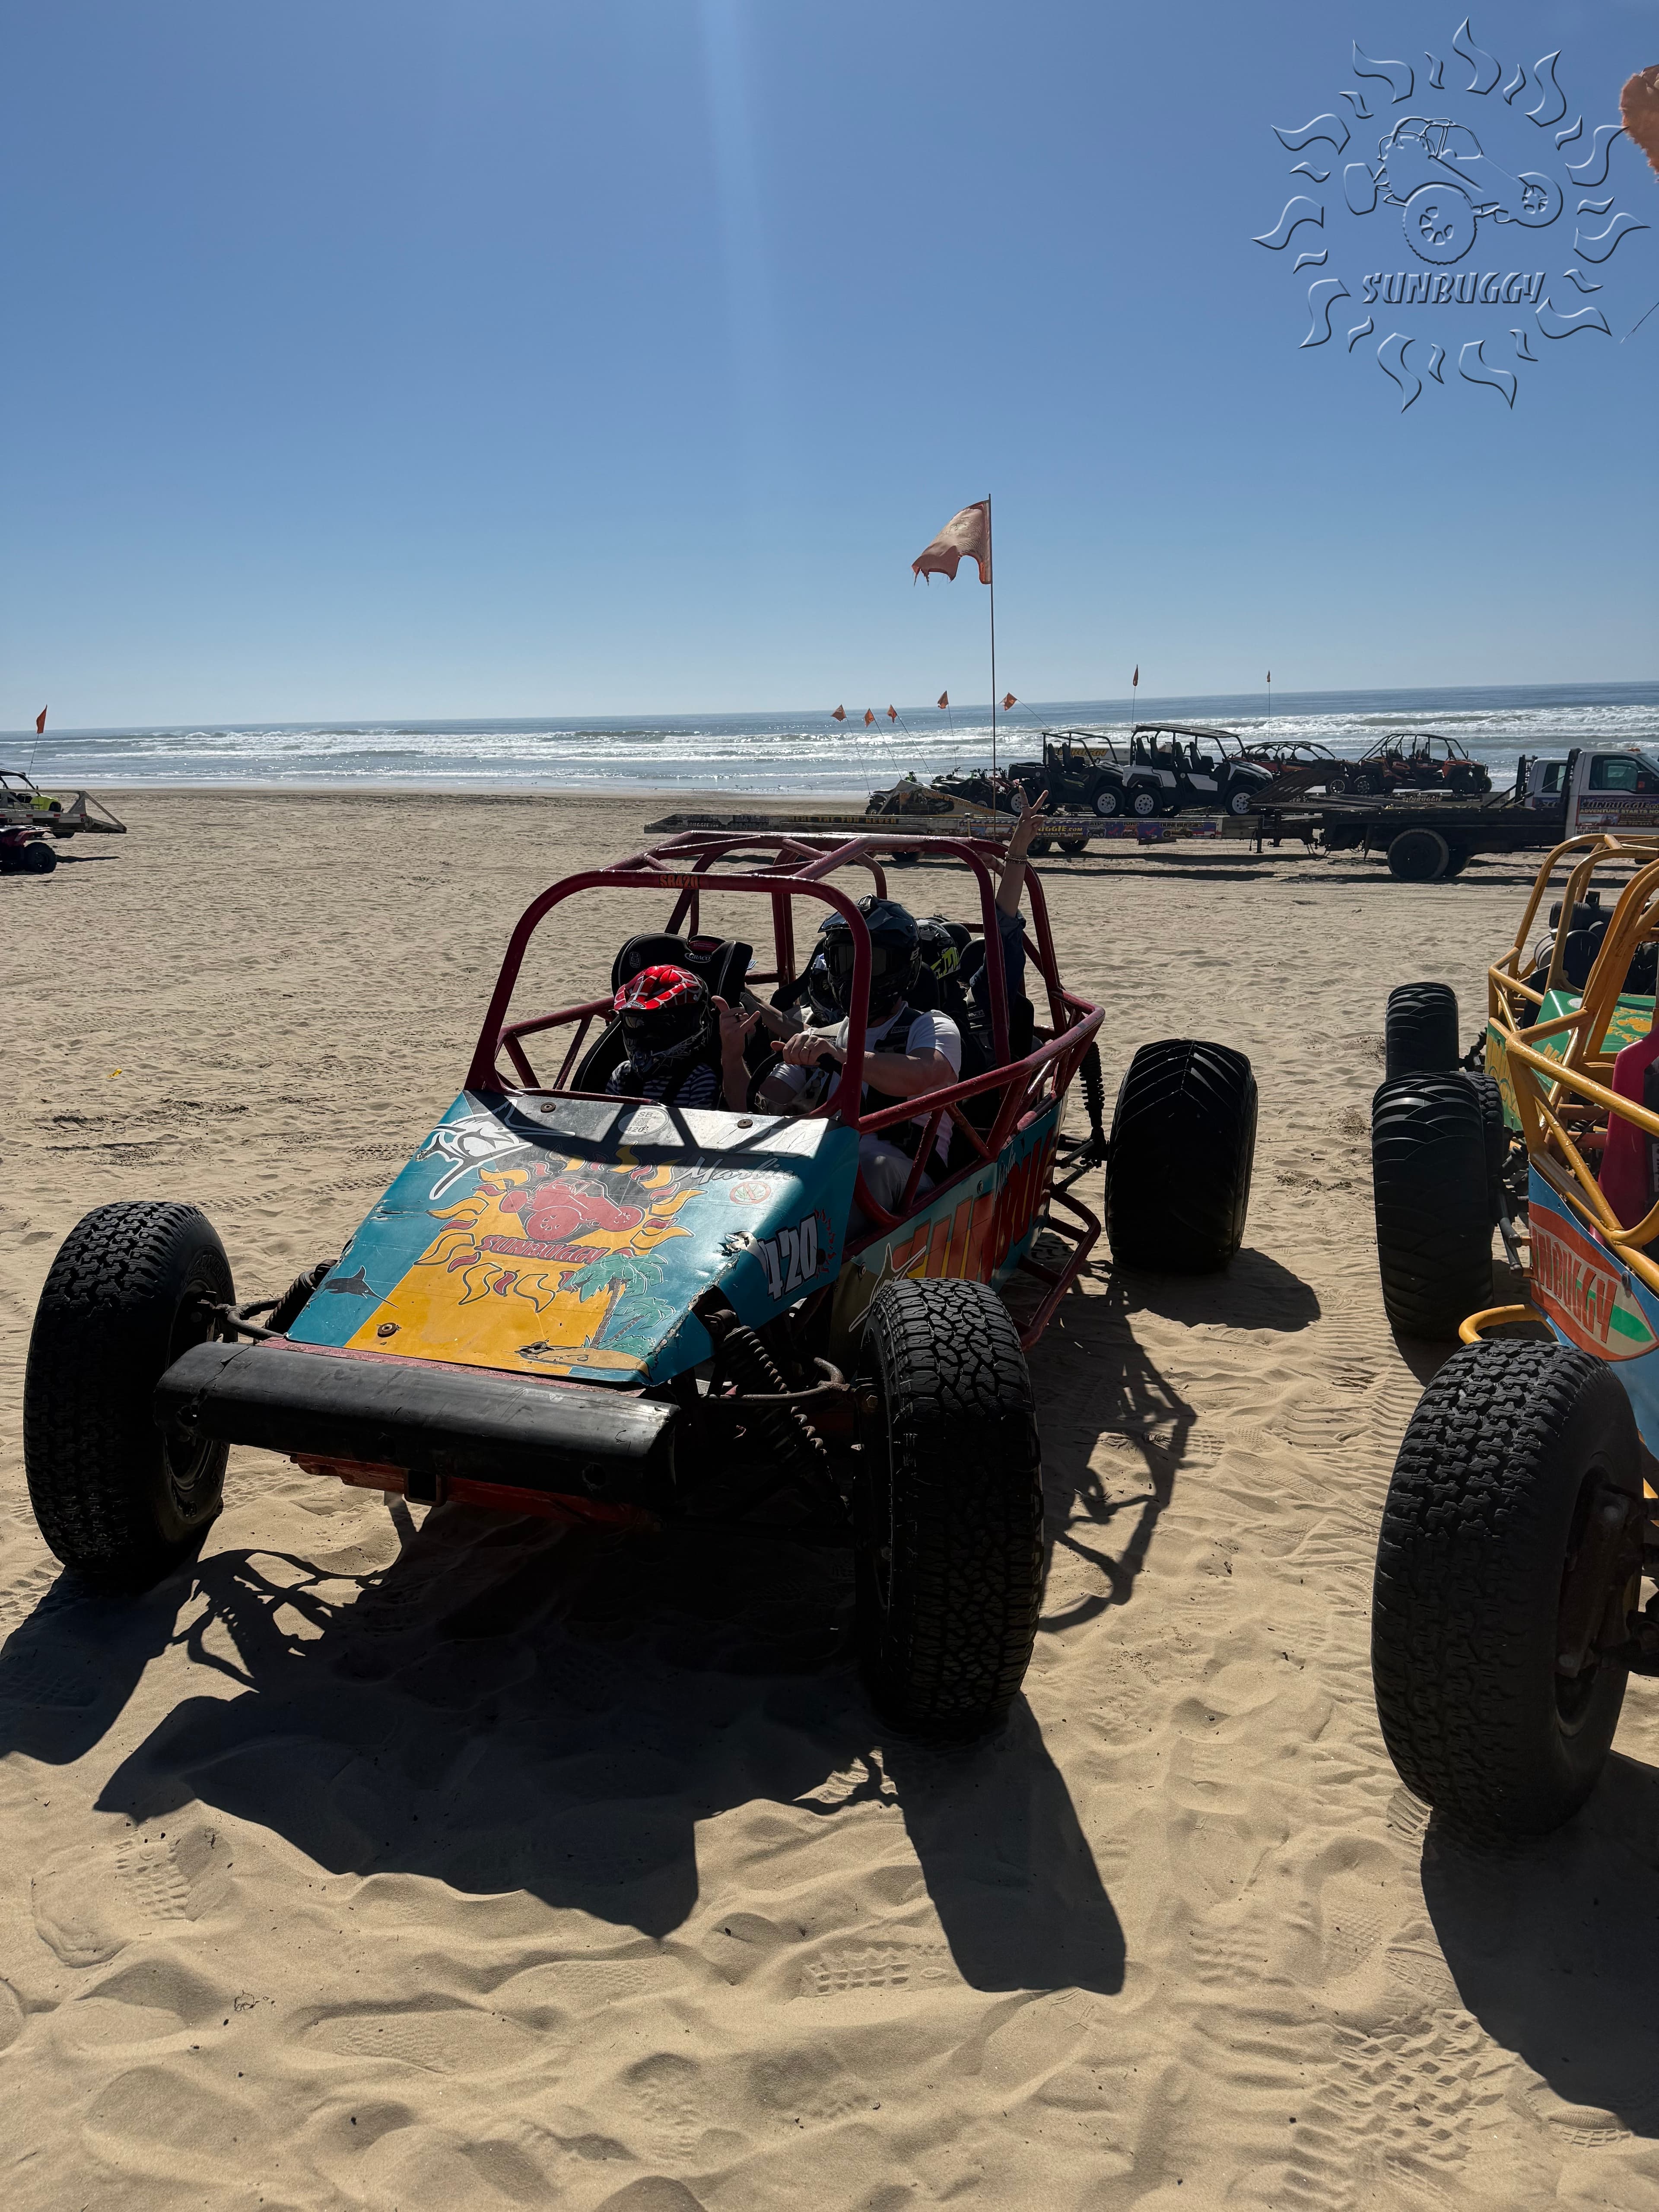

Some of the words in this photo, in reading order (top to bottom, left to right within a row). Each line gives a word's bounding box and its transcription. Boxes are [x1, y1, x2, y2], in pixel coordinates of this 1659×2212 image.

[674, 1156, 799, 1185] Marlin
[475, 1235, 607, 1264] SUNBUGGY
[757, 1212, 818, 1302] 420
